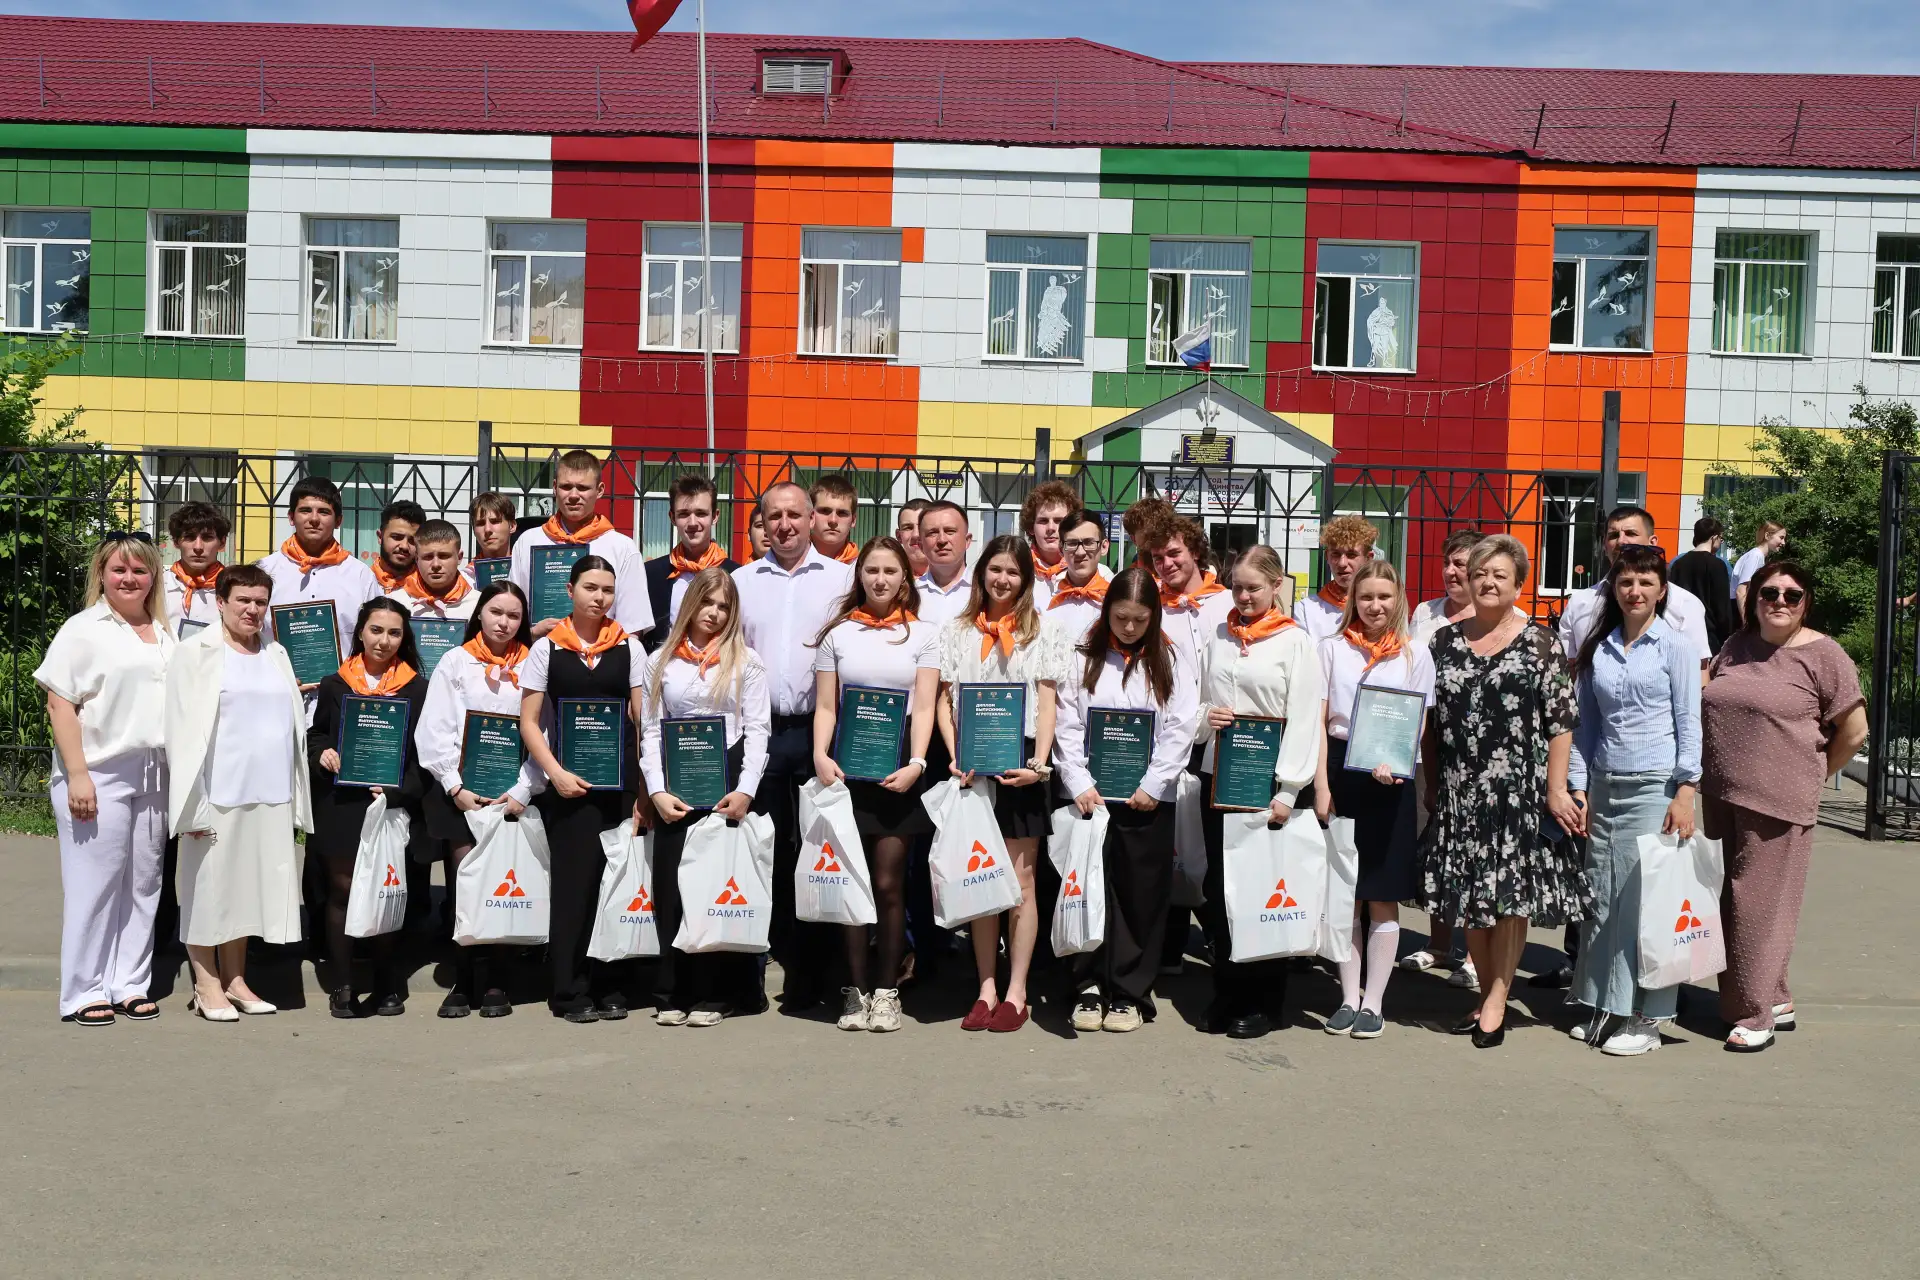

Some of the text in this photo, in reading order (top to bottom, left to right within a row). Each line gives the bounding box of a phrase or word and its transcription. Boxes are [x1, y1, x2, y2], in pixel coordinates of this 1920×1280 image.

[808, 876, 849, 885] DAMATE
[964, 868, 1004, 886] DAMATE
[486, 900, 532, 908] DAMATE
[708, 908, 754, 918] DAMATE
[1260, 911, 1306, 922] DAMATE
